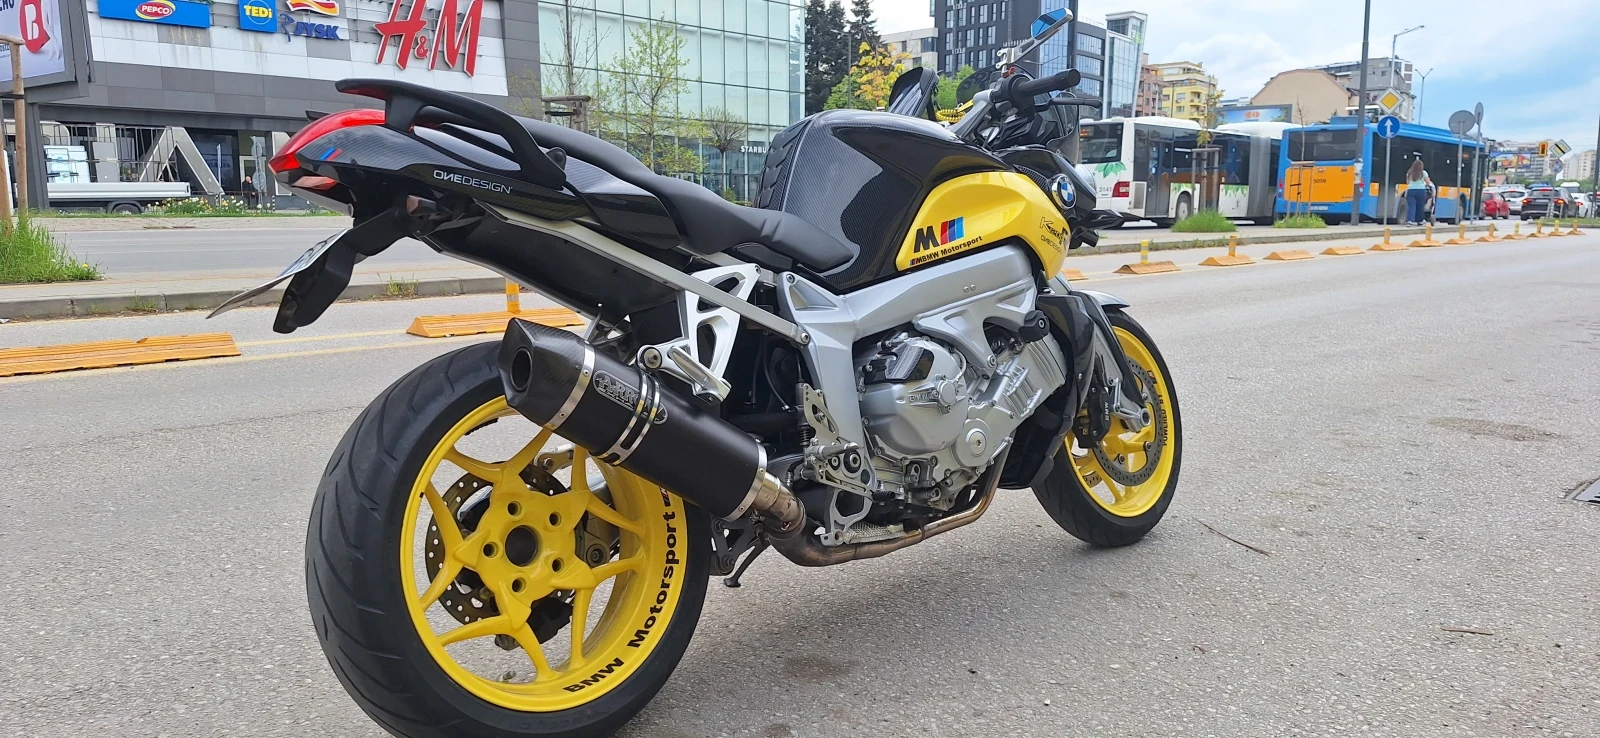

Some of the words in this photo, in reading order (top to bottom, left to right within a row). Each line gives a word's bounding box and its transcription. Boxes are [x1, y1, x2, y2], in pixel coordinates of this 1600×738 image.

[141, 5, 170, 15] PEPCO
[243, 5, 273, 19] TEDi
[294, 21, 340, 40] JYSK
[373, 0, 485, 78] H&M
[740, 145, 771, 154] STARBU
[940, 235, 983, 256] Motorsport
[562, 657, 625, 693] BMW
[627, 511, 680, 648] Motorsport
